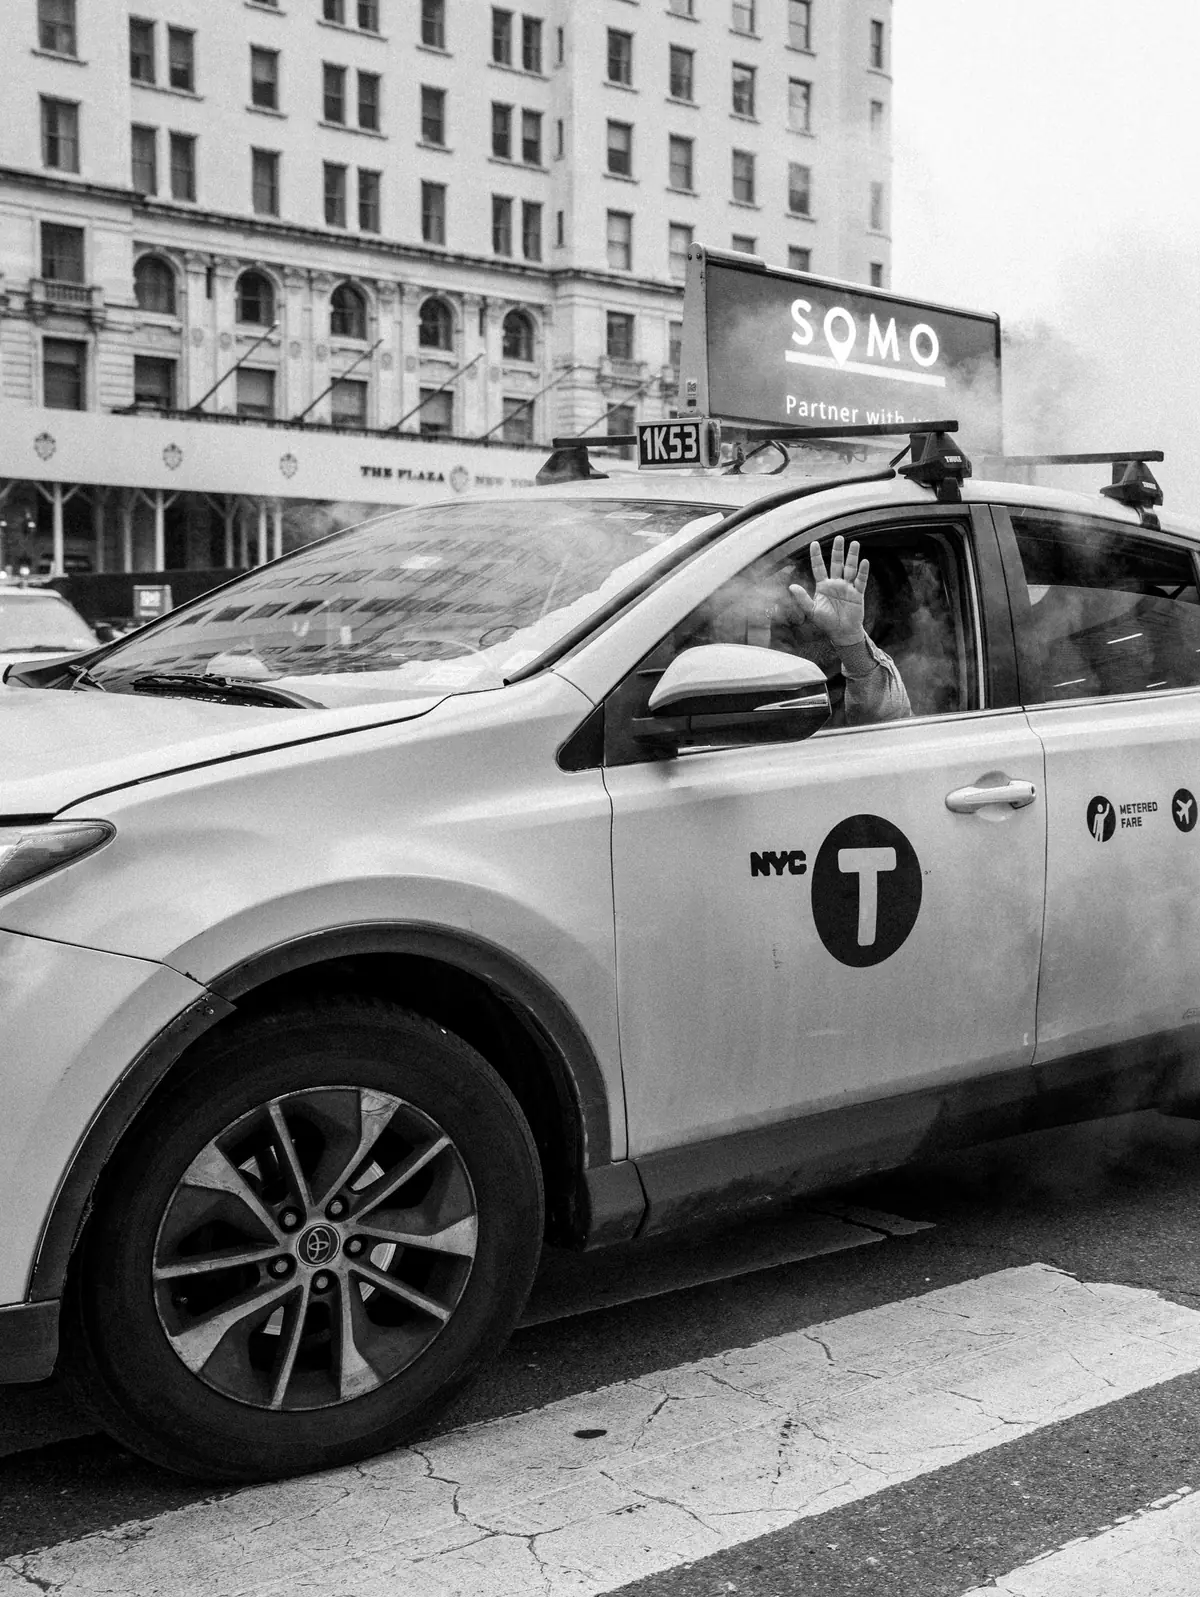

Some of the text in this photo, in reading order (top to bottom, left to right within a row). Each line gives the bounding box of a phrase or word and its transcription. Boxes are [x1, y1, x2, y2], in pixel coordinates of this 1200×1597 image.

[790, 299, 940, 367] SOMO
[786, 394, 859, 423] Partner
[642, 425, 698, 460] 1K53
[360, 465, 393, 478] THE
[398, 468, 445, 482] PLAZA
[1119, 801, 1158, 815] METERED
[1121, 816, 1143, 829] FARE
[750, 850, 807, 877] NYC
[838, 846, 897, 946] T
